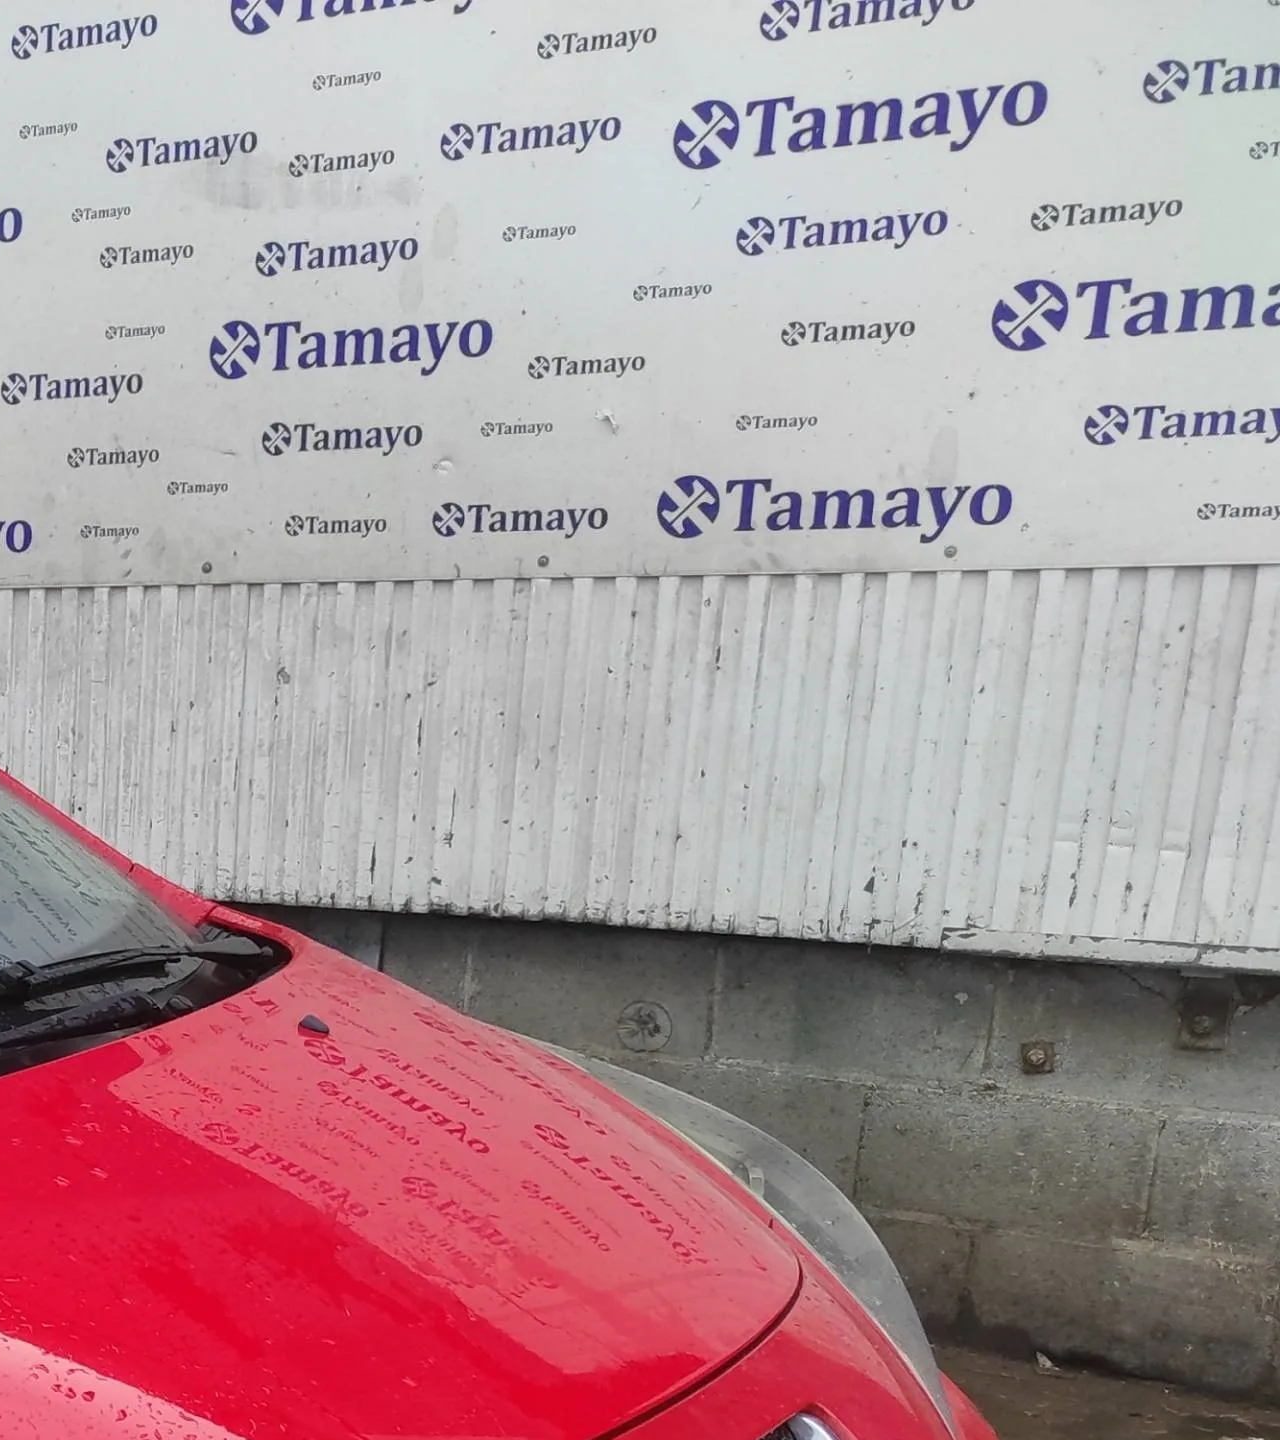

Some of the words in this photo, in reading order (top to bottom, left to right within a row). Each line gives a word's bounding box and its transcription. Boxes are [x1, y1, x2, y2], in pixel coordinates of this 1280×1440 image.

[41, 15, 157, 53] Tamayo
[562, 28, 656, 54] Tamayo
[327, 72, 381, 88] Tamayo
[31, 123, 77, 136] Tamayo
[746, 81, 1047, 157] Tamayo
[477, 117, 621, 154] Tamayo
[136, 132, 257, 167] Tamayo
[310, 150, 394, 173] Tamayo
[84, 207, 131, 220] Tamayo
[1062, 200, 1182, 226] Tamayo
[518, 226, 576, 240] Tamayo
[779, 210, 948, 249] Tamayo
[119, 245, 193, 265] Tamayo
[288, 238, 418, 271] Tamayo
[649, 285, 712, 299] Tamayo
[118, 326, 166, 340] Tamayo
[809, 321, 915, 344] Tamayo
[264, 320, 492, 376] Tamayo
[552, 356, 645, 378] Tamayo
[29, 374, 143, 403] Tamayo
[495, 423, 553, 436] Tamayo
[752, 416, 817, 431] Tamayo
[294, 424, 422, 456] Tamayo
[86, 448, 159, 468] Tamayo
[180, 482, 228, 495] Tamayo
[468, 504, 608, 539] Tamayo
[726, 479, 1012, 543] Tamayo
[93, 525, 140, 540] Tamayo
[305, 516, 386, 537] Tamayo
